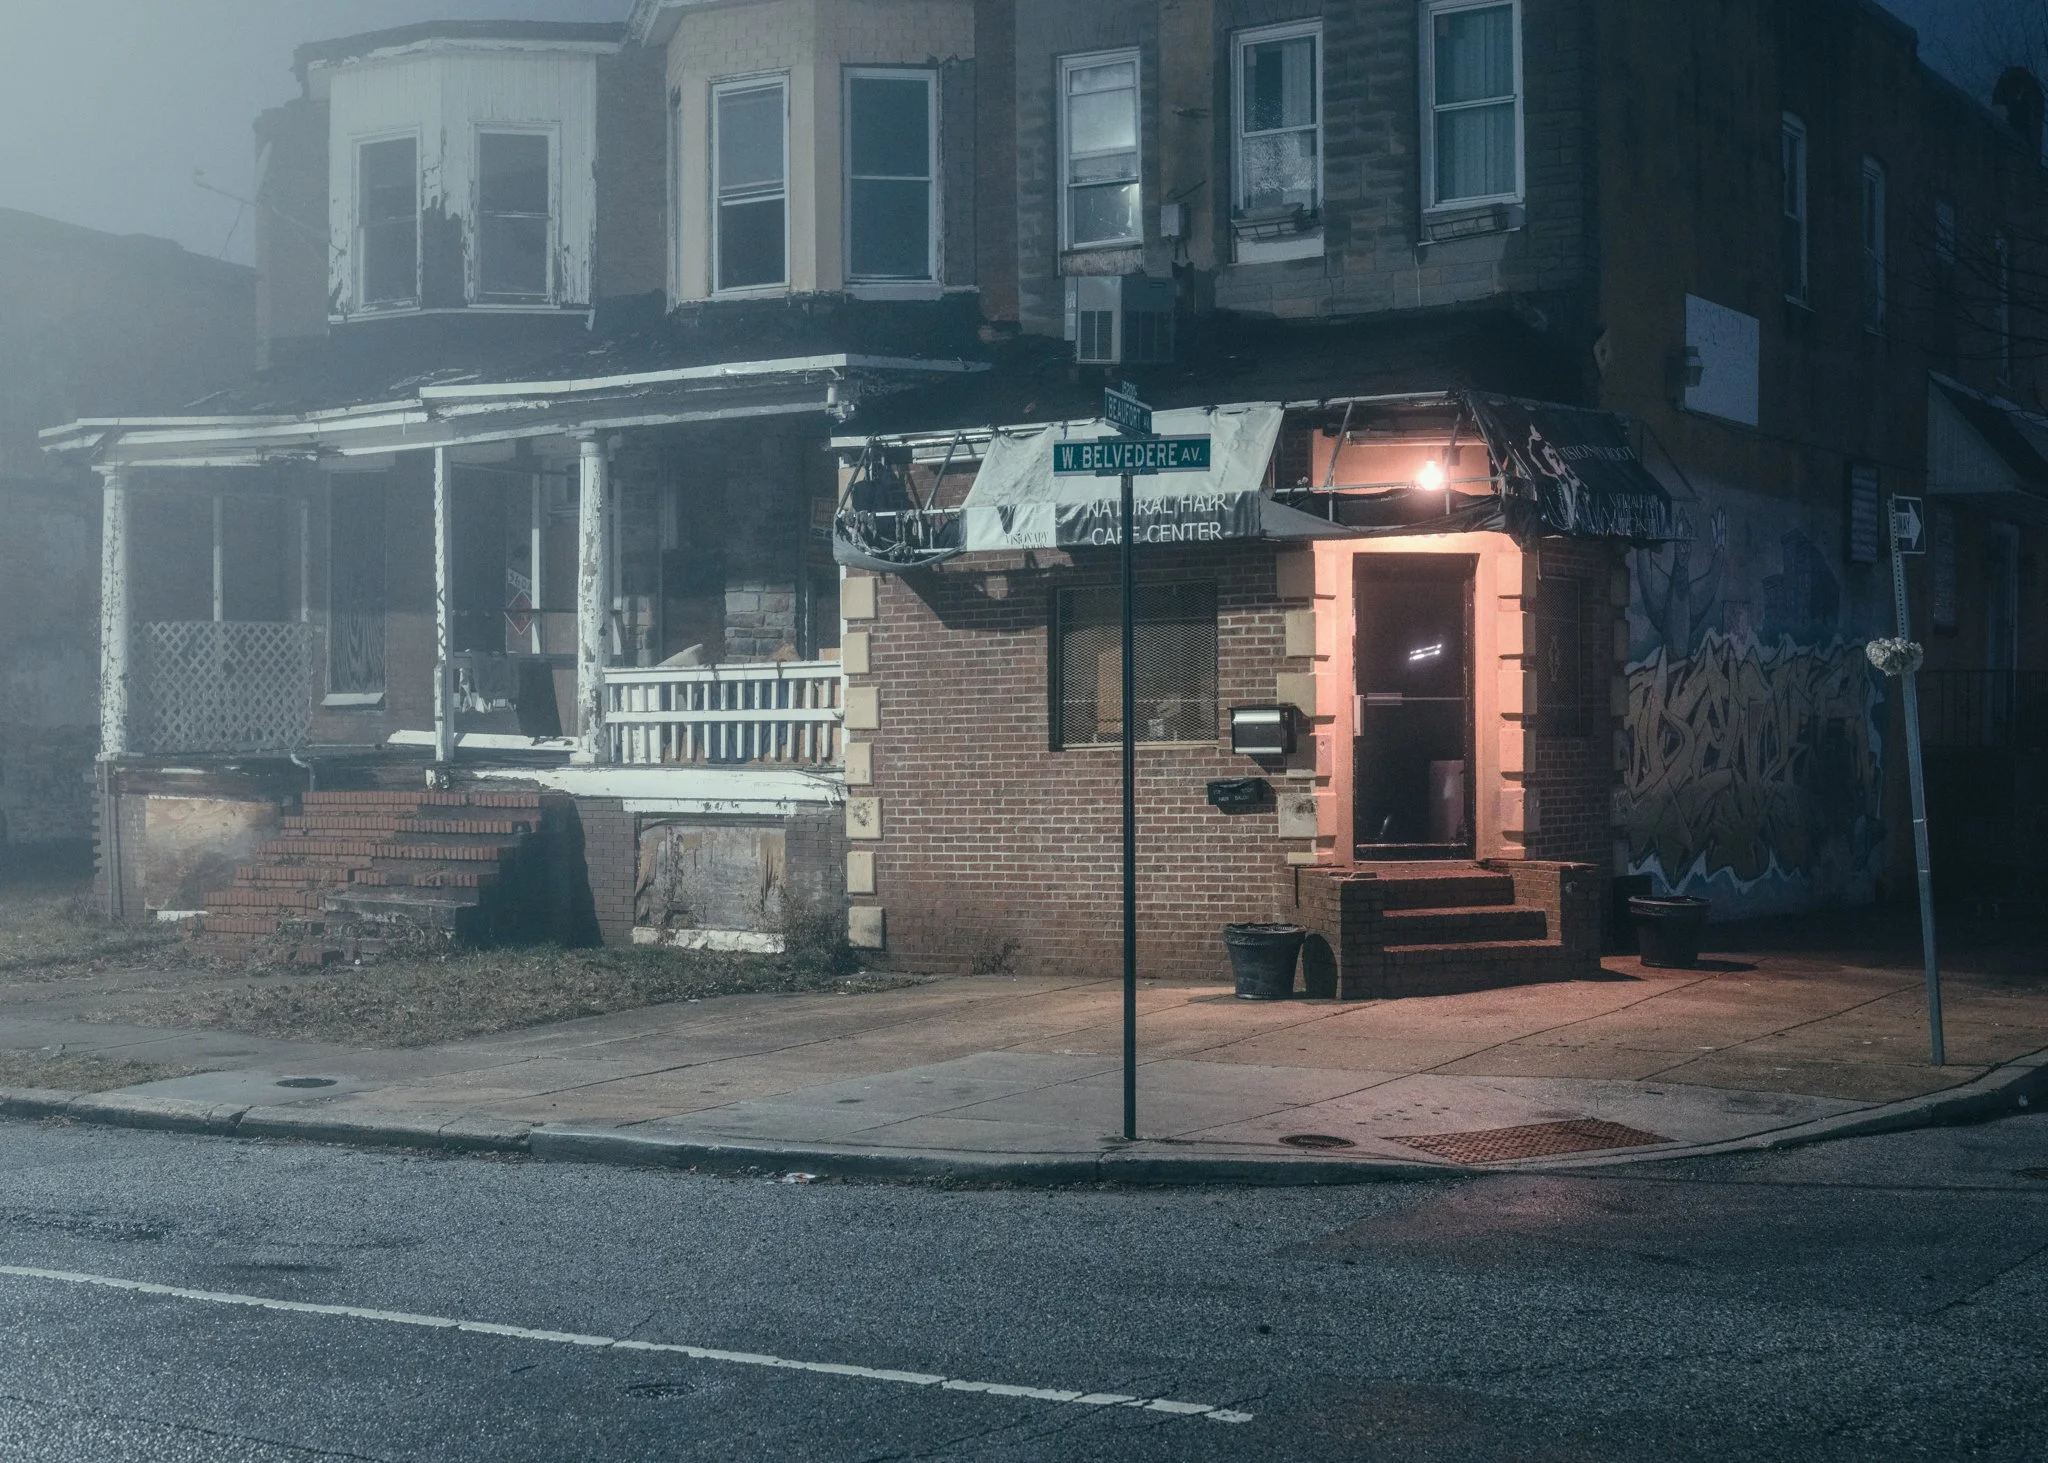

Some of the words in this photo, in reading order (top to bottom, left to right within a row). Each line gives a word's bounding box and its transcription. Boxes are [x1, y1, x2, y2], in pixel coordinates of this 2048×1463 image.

[1108, 396, 1141, 430] BEAUFORT
[1062, 446, 1077, 469] W.
[1082, 443, 1178, 468] BELVEDERE
[1181, 447, 1203, 461] AV.
[1180, 492, 1228, 512] HAIR
[1147, 521, 1223, 543] CENTER
